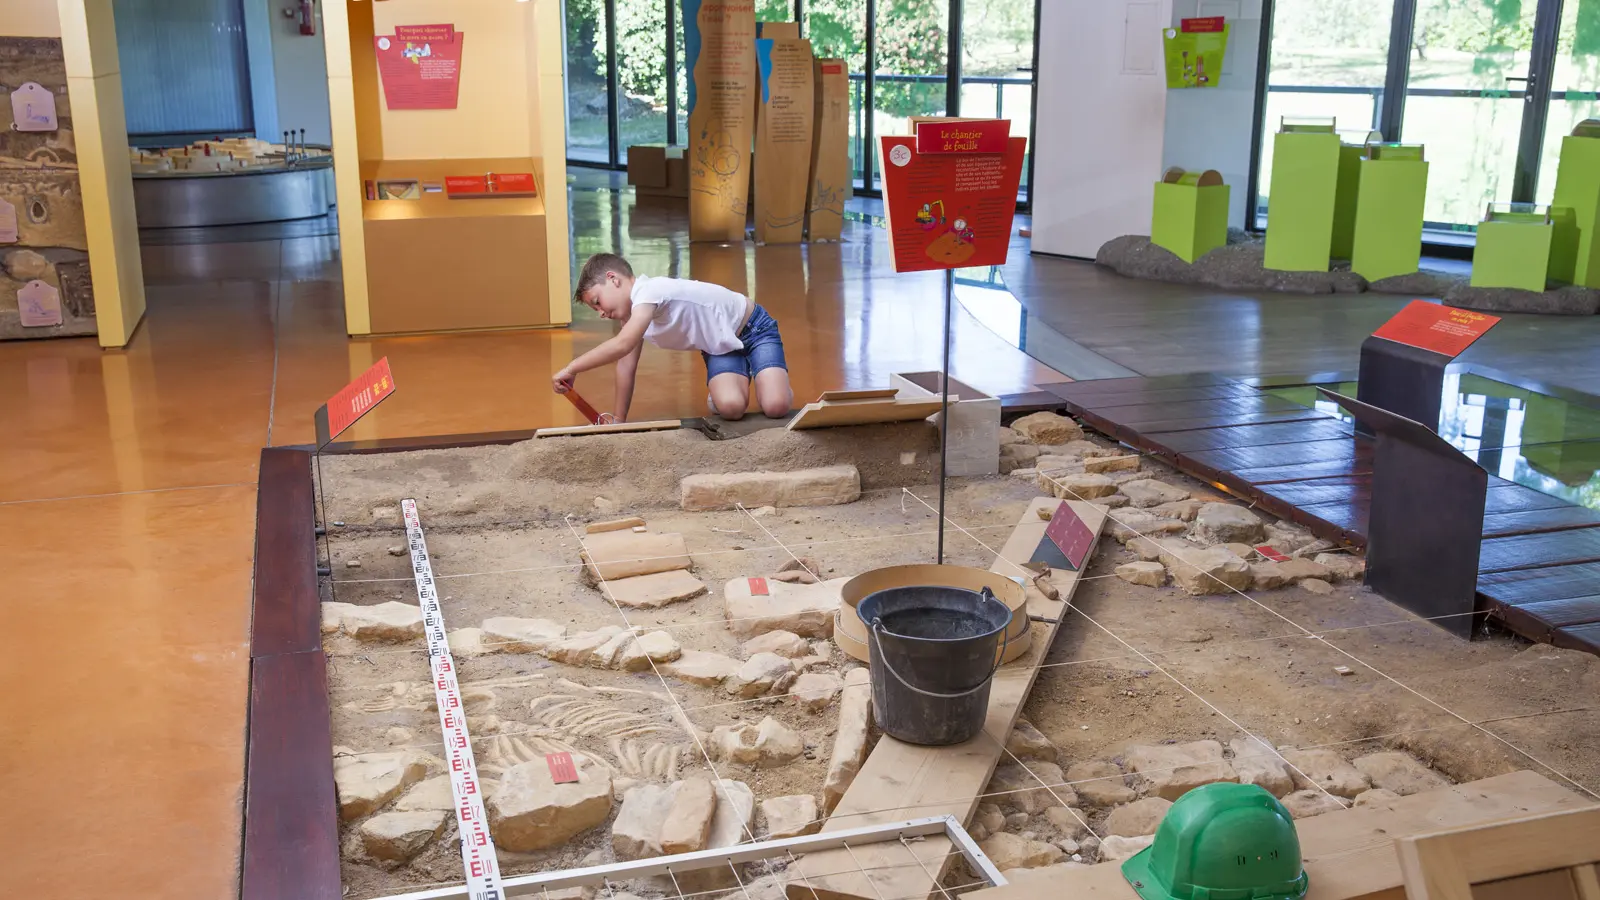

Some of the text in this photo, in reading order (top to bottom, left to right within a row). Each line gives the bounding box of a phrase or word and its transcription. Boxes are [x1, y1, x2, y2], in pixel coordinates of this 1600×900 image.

[941, 128, 982, 139] Le chantier
[944, 140, 978, 151] de fouille
